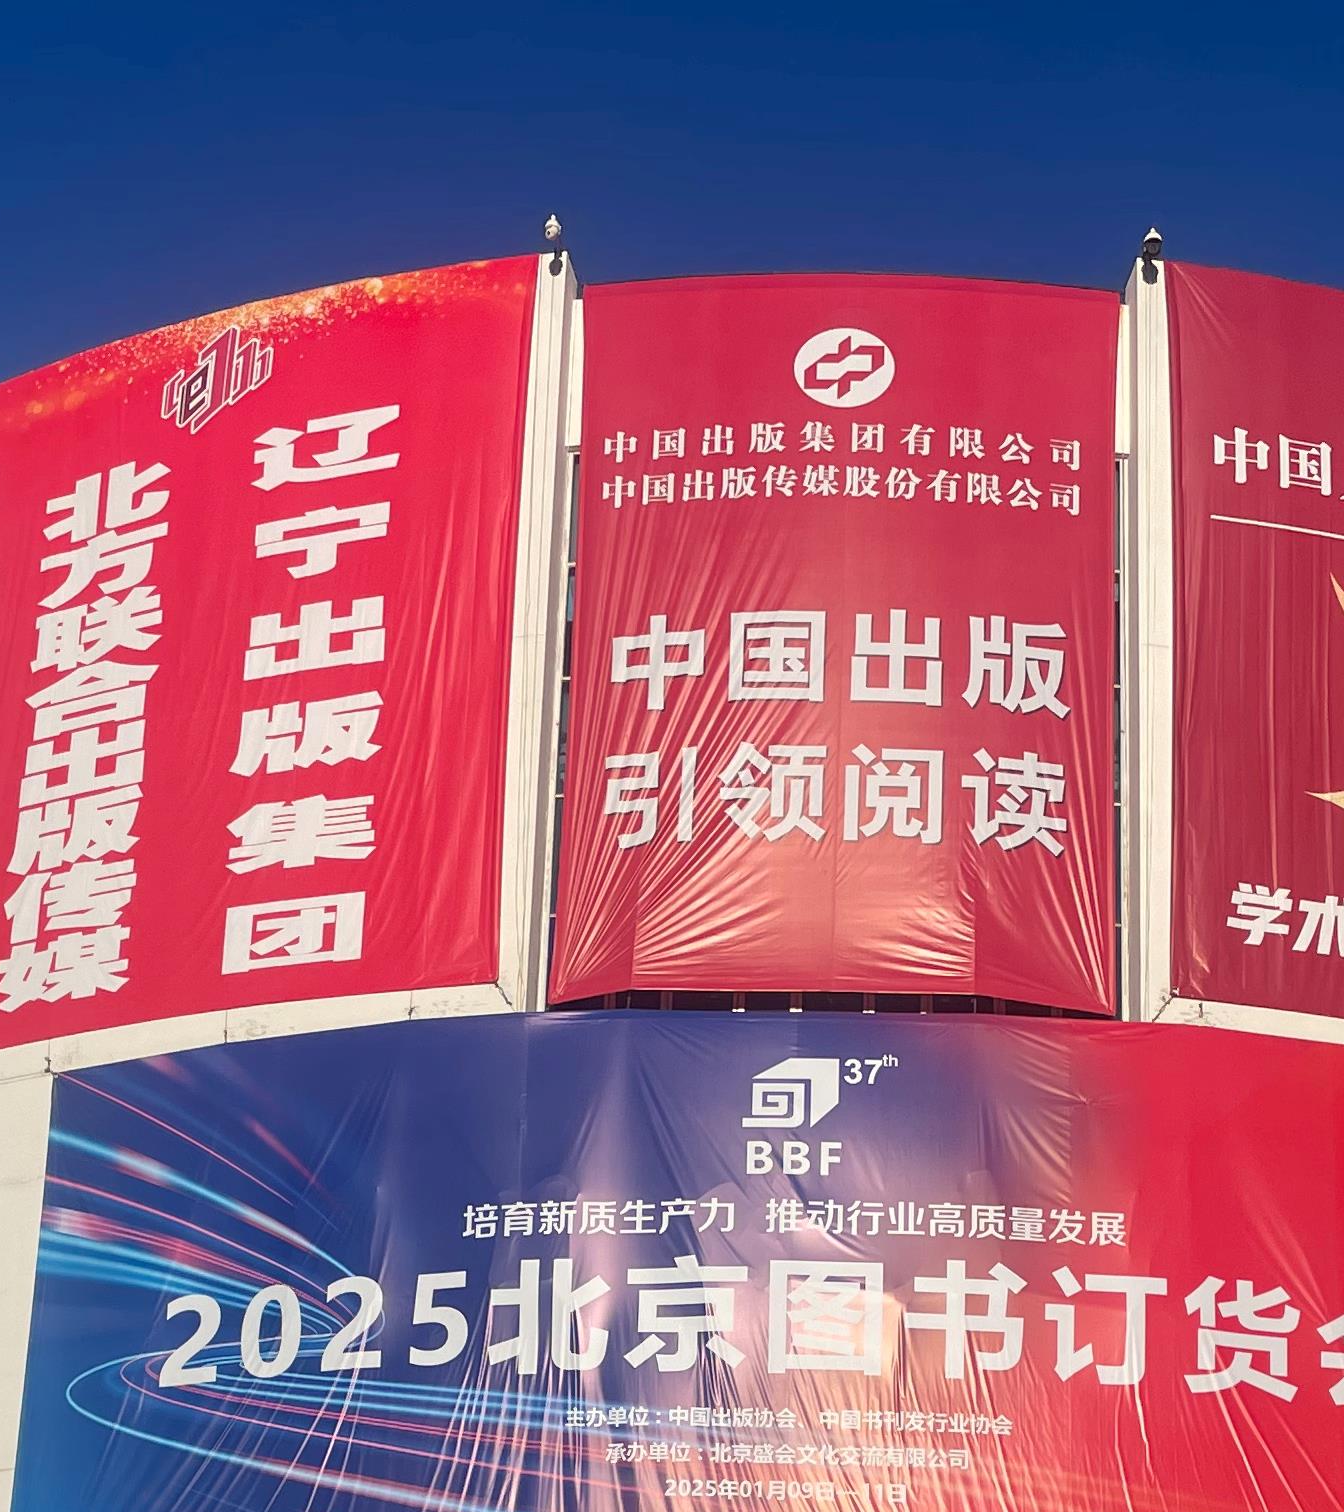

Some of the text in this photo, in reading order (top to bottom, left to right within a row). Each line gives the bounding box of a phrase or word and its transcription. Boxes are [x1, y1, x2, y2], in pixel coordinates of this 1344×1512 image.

[603, 420, 1082, 472] 中国出版集团有限公司
[601, 464, 1081, 516] 中国出版传媒股份有限公司
[610, 608, 1072, 720] 中国出版
[221, 405, 400, 976] 辽宁出版集团
[603, 740, 1068, 857] 引领阅读
[843, 1054, 898, 1085] 37th
[746, 1140, 842, 1176] BBF
[462, 1197, 1127, 1249] 培育新质生产力 推动行业高质量发展
